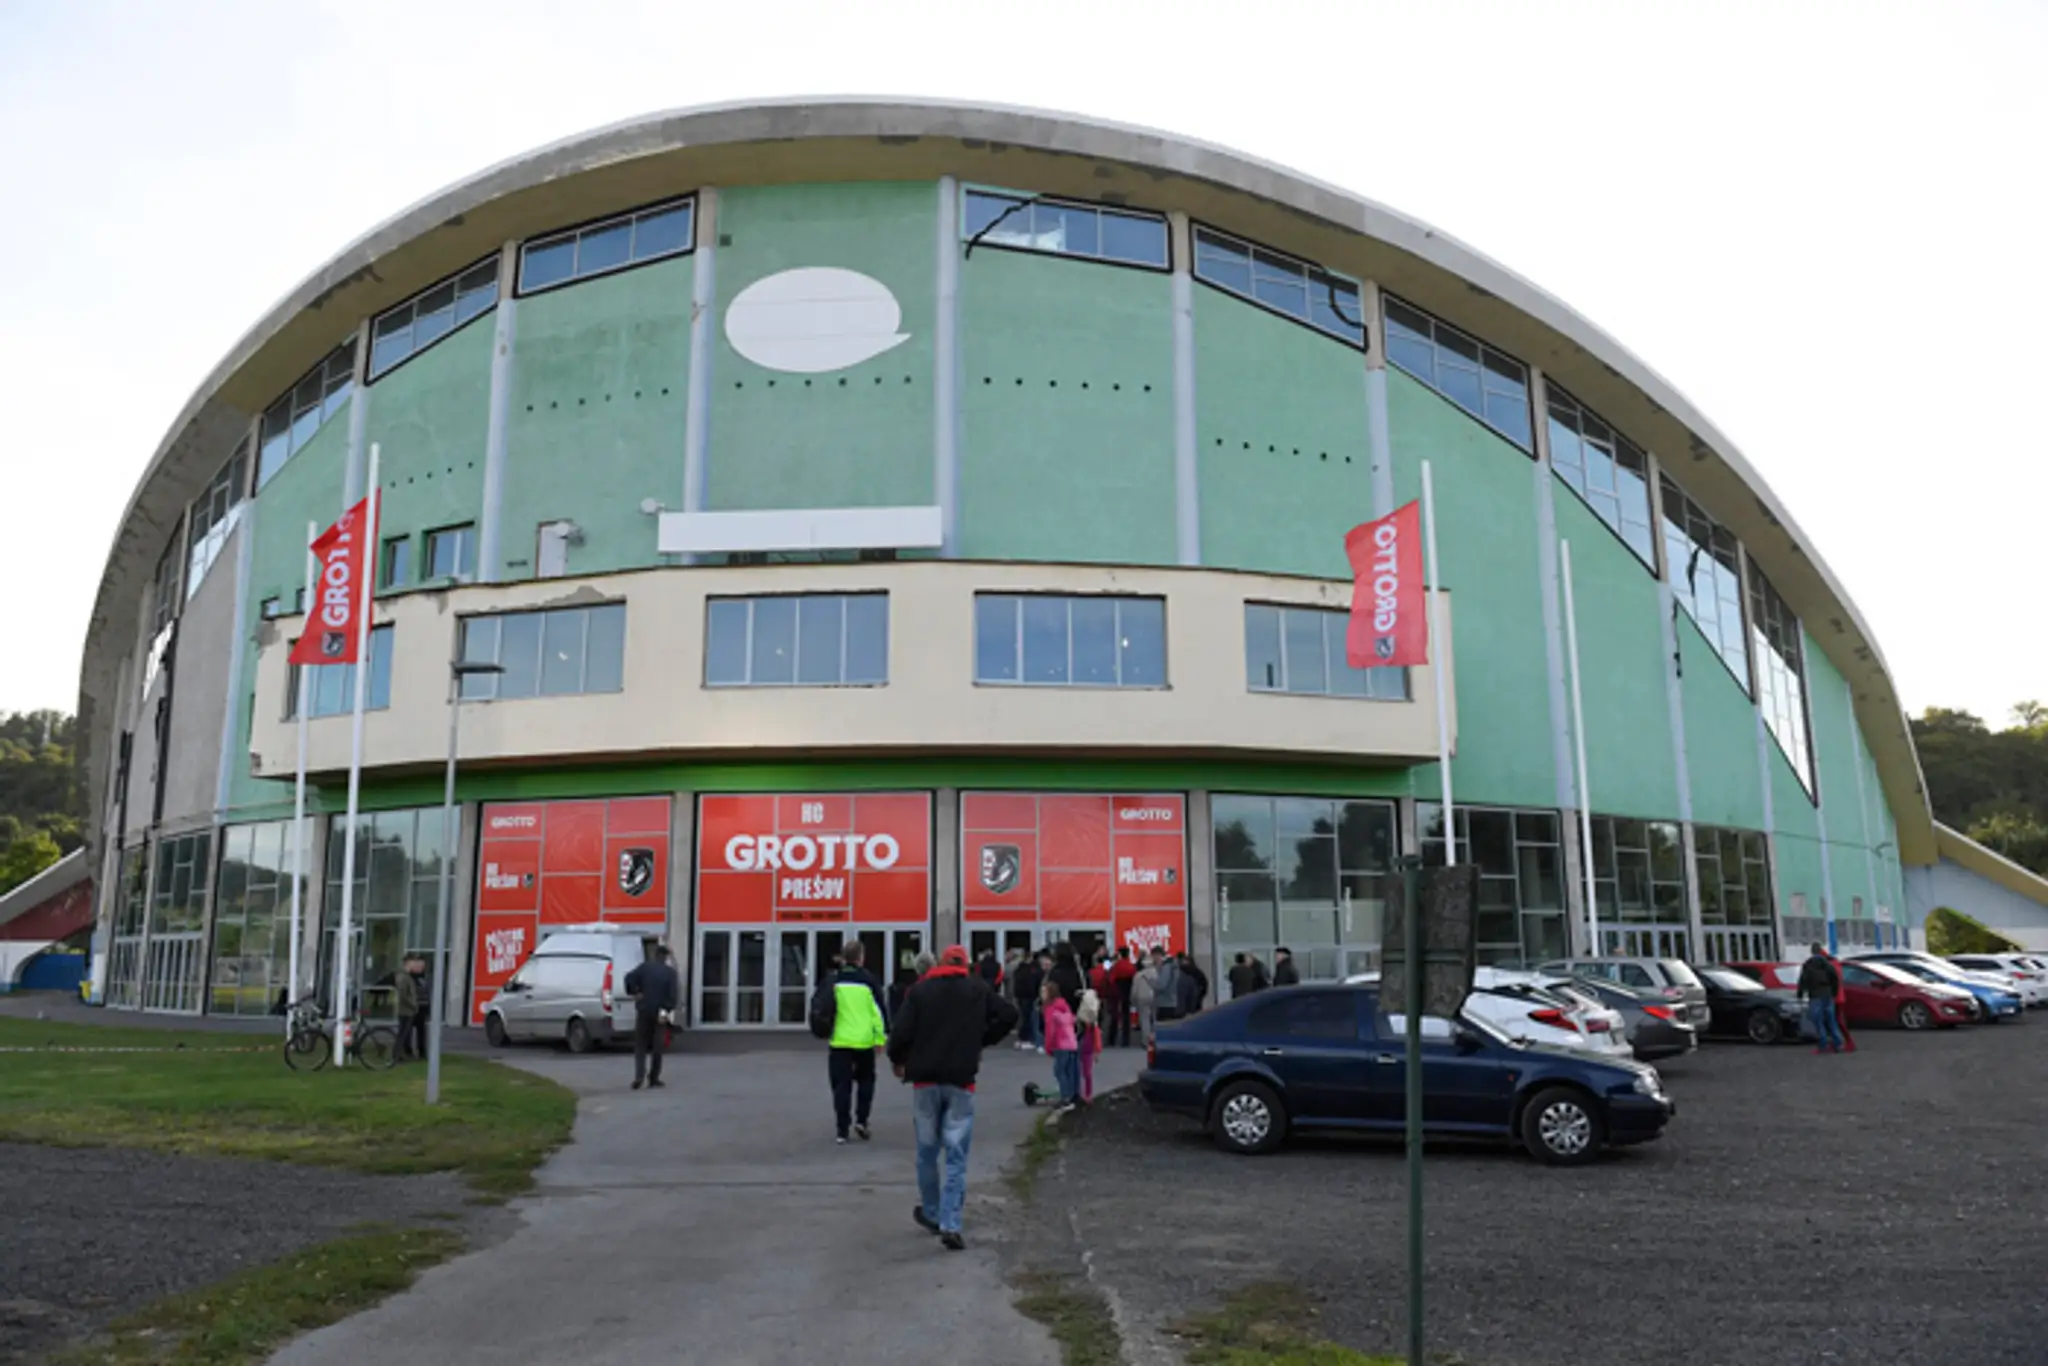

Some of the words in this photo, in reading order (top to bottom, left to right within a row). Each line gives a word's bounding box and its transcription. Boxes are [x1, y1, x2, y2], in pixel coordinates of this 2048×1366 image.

[491, 816, 536, 829] GROTTO
[1120, 808, 1172, 821] GROTTO
[725, 833, 899, 870] GROTTO
[781, 874, 844, 900] PREŠOV
